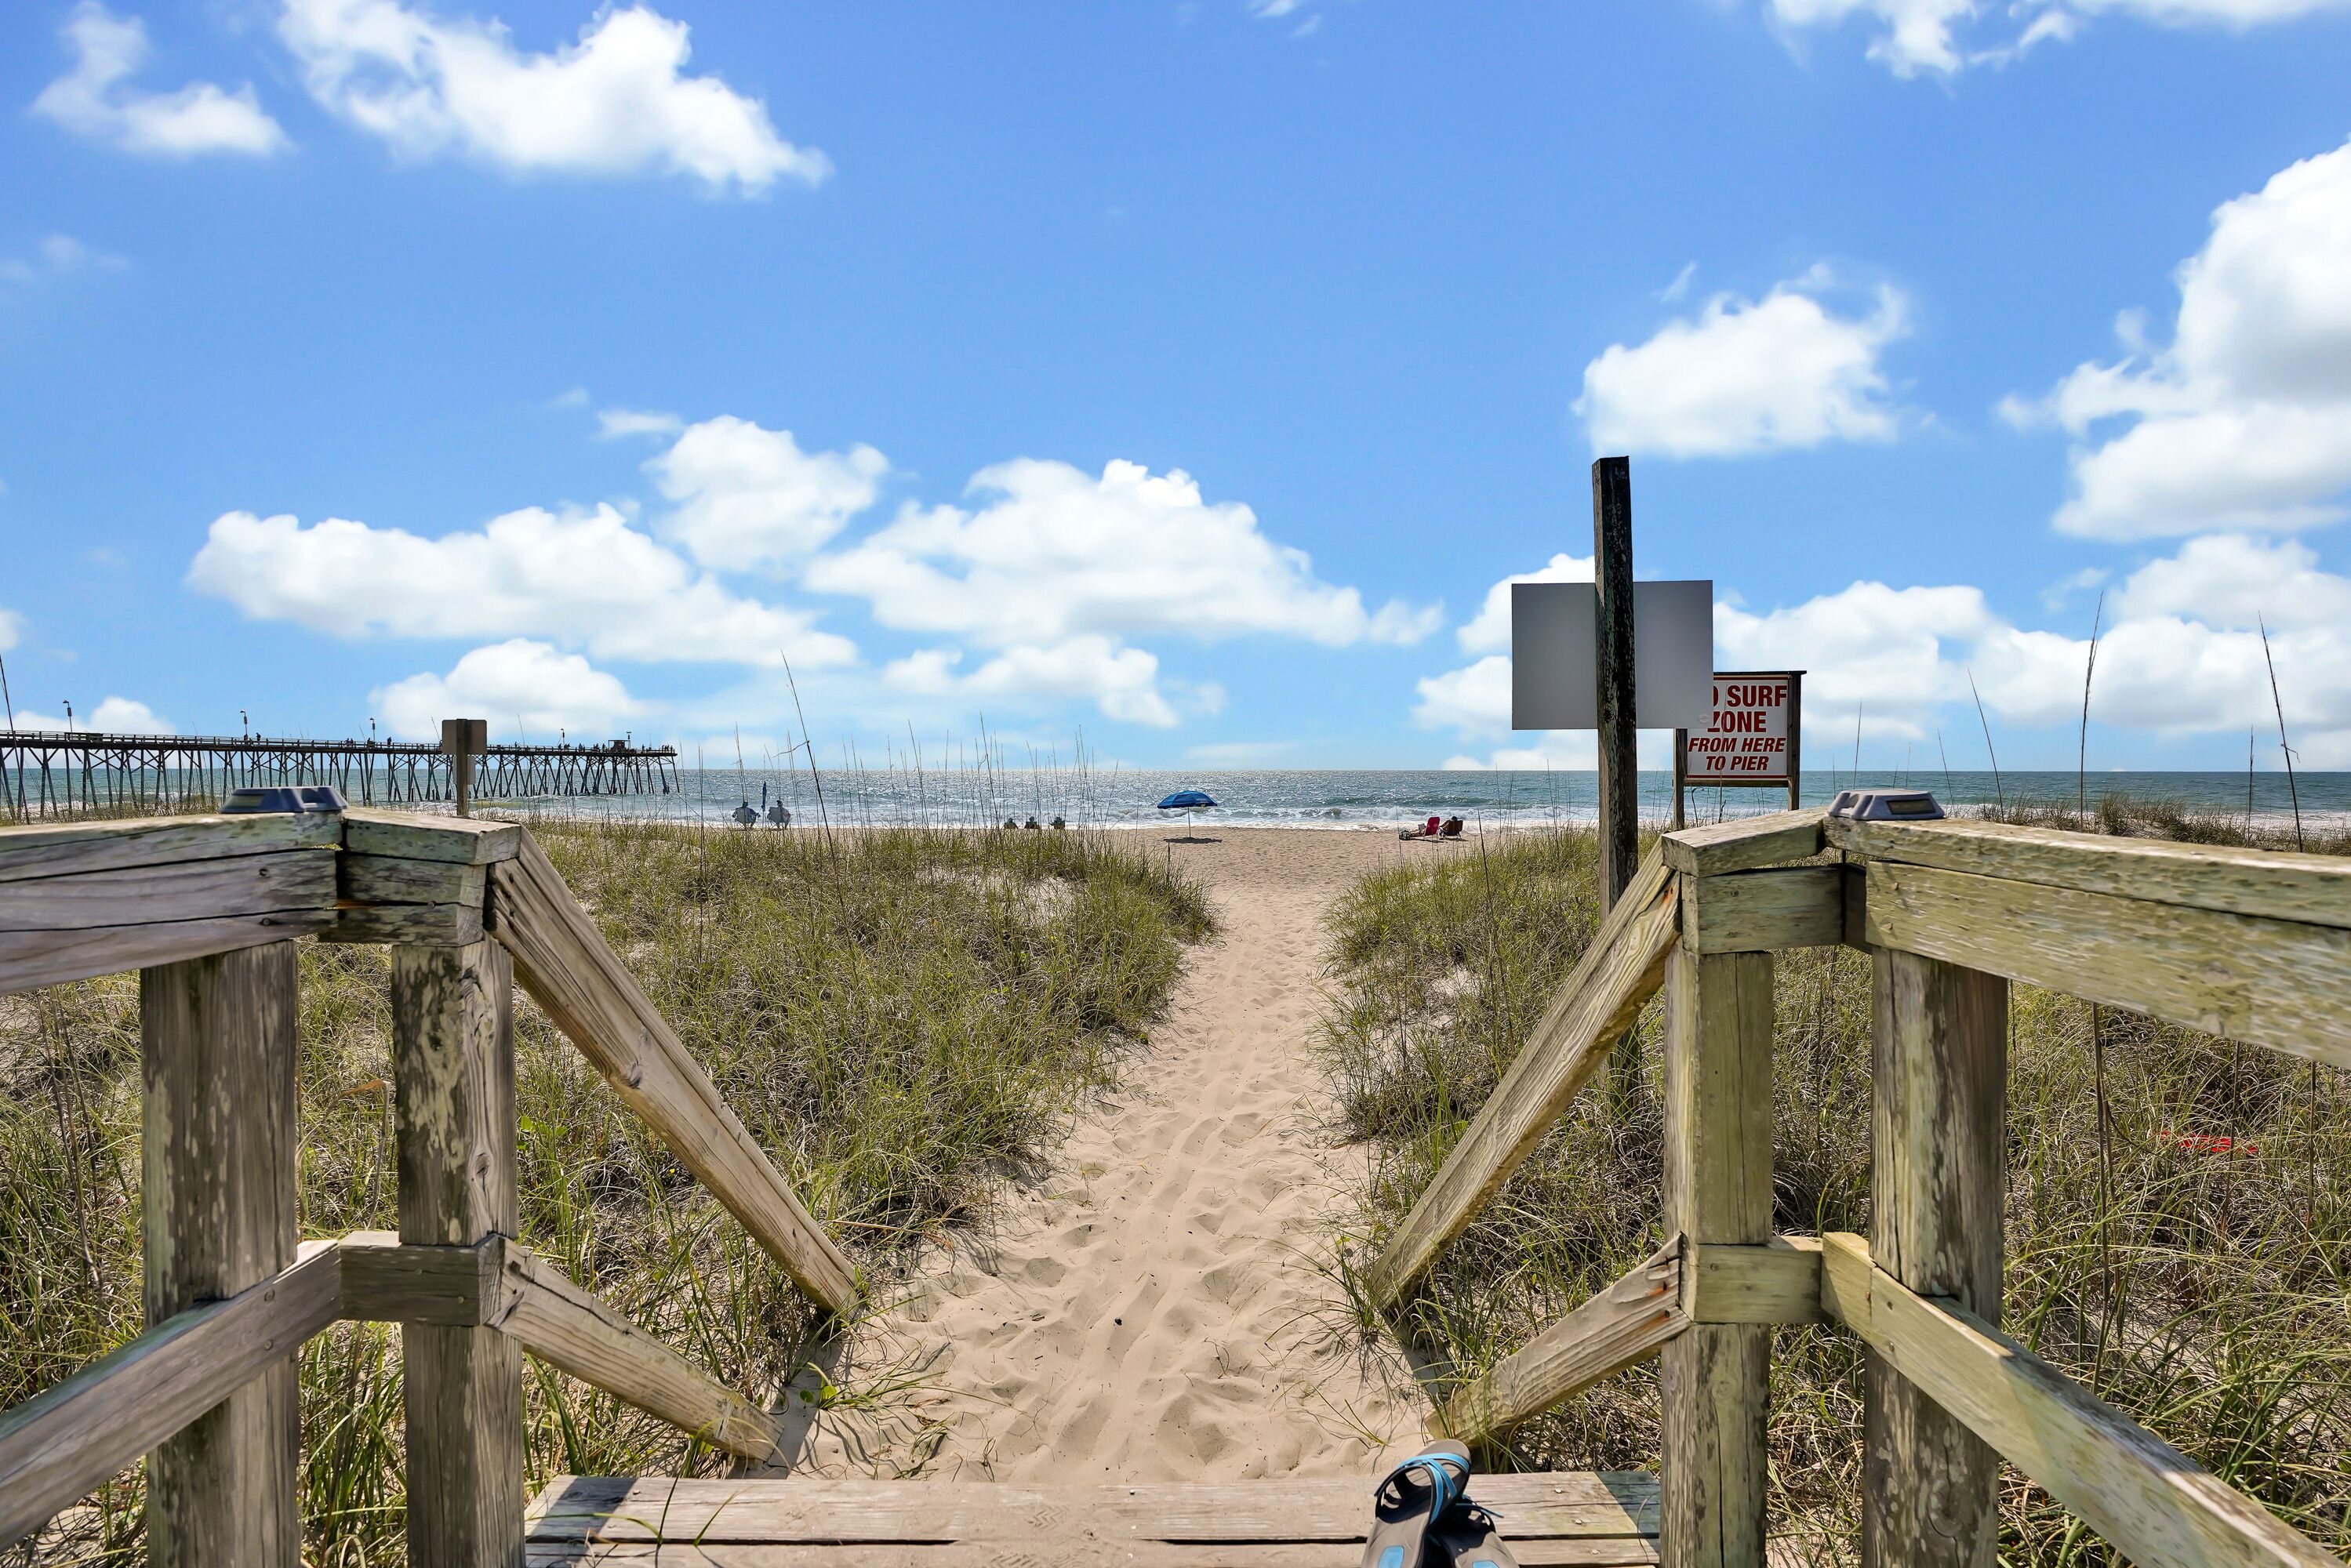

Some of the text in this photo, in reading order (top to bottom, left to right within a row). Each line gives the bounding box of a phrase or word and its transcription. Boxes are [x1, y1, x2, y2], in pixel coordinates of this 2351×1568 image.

[1726, 684, 1787, 707] SURF
[1688, 737, 1786, 753] FROM HERE
[1706, 756, 1769, 771] TO PIER
